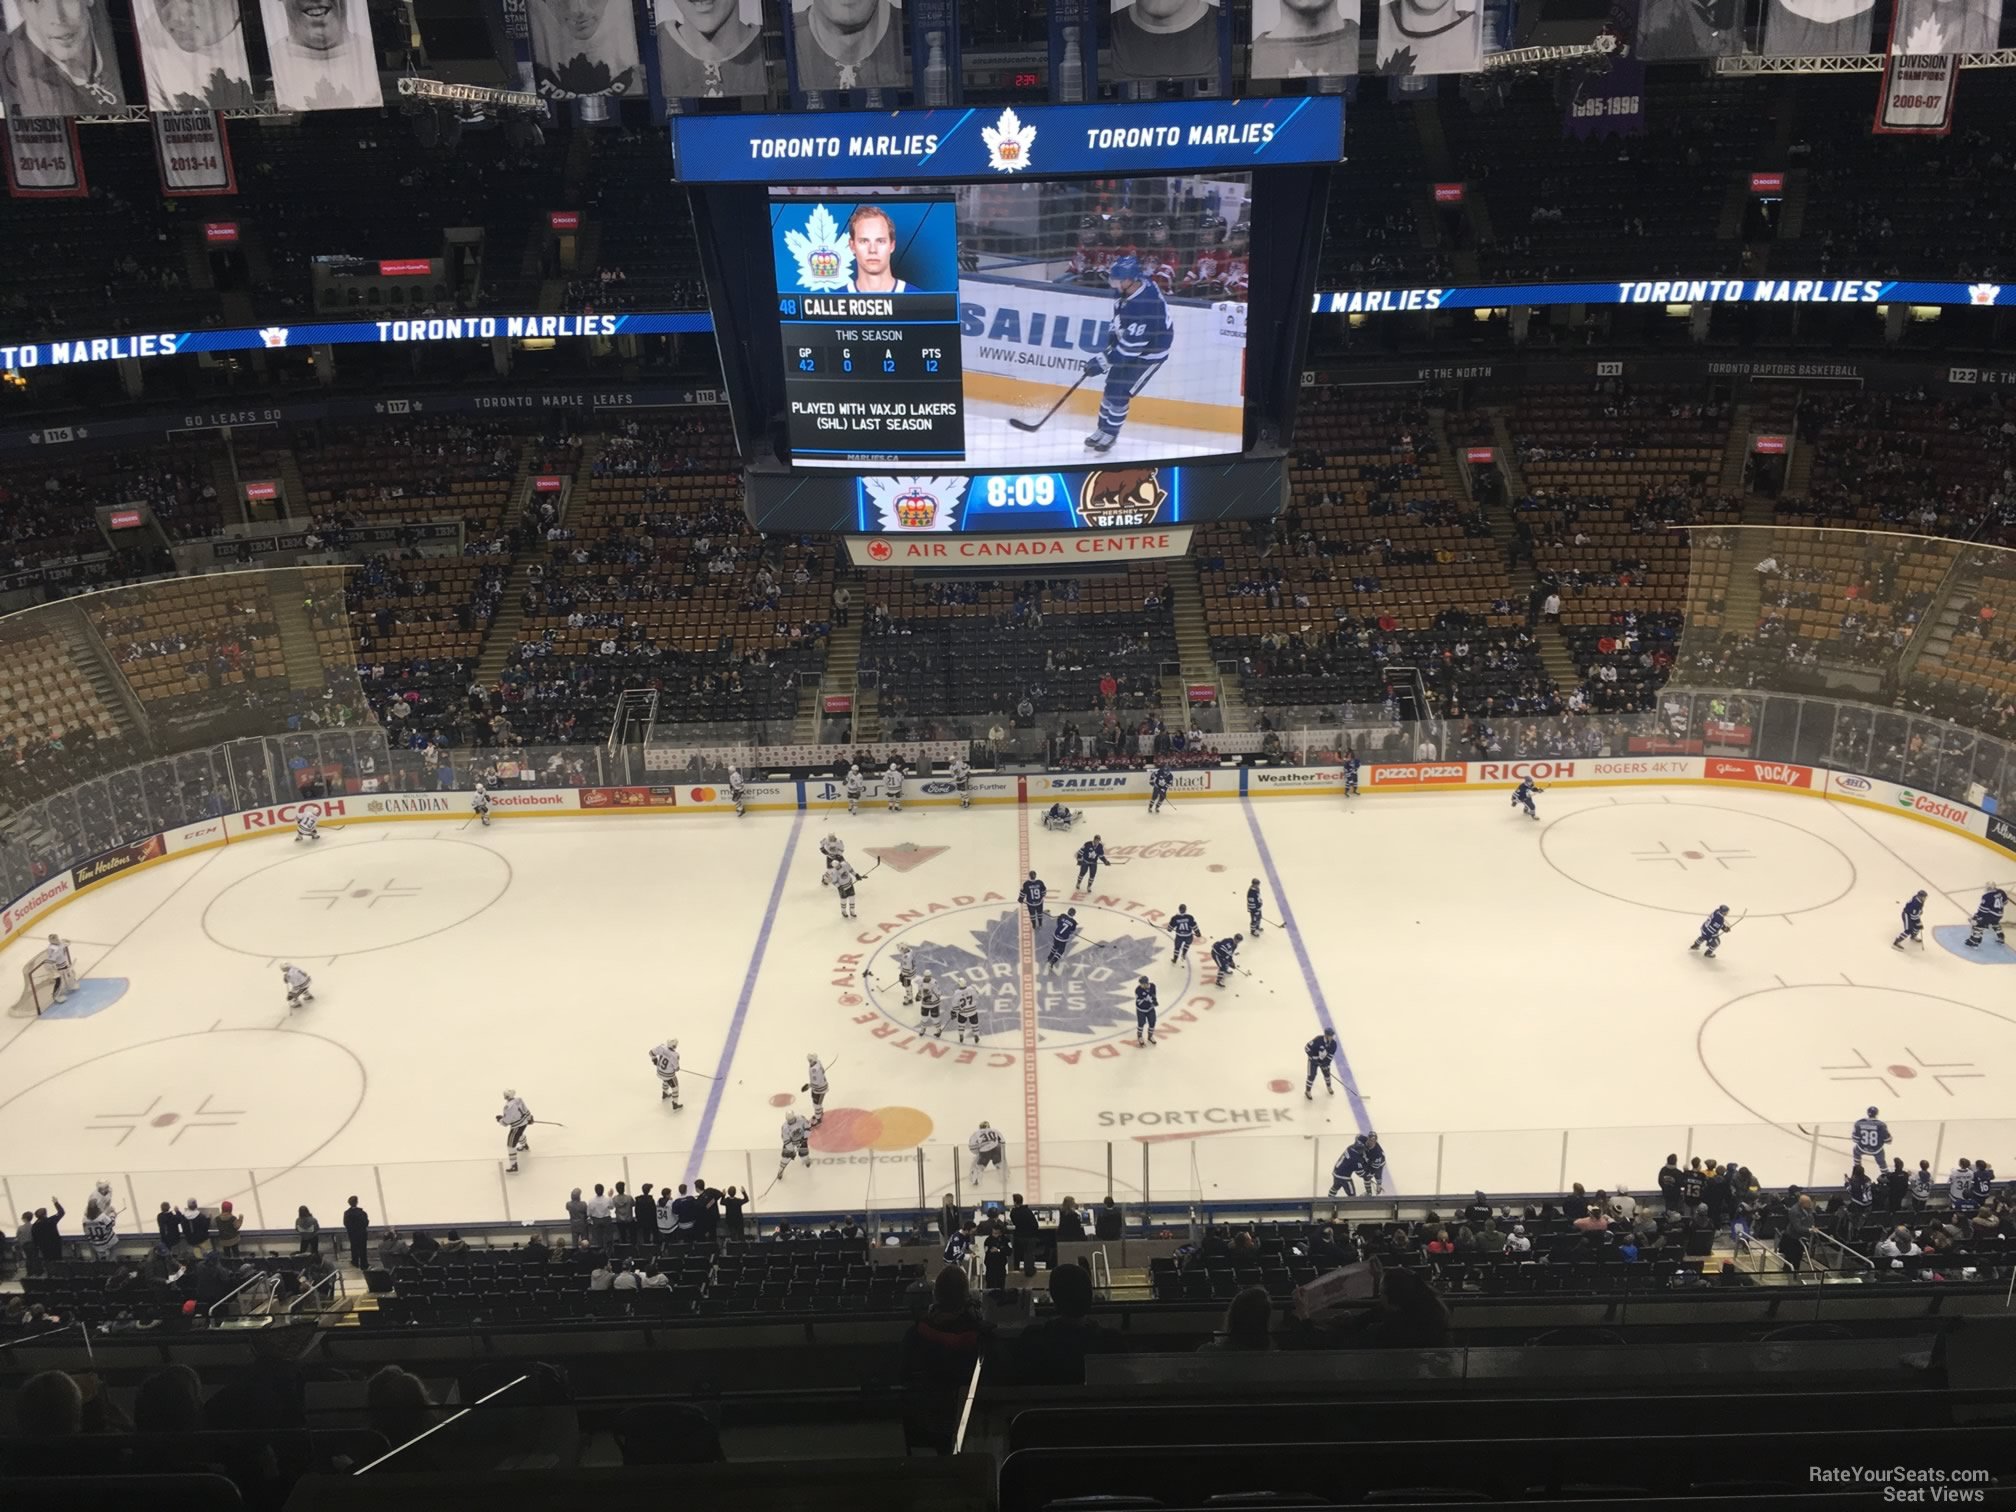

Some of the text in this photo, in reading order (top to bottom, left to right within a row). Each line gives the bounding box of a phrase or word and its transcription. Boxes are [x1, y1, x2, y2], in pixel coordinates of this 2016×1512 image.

[972, 56, 1048, 65] aircanadacentre.co
[1899, 55, 1948, 68] DIVISION
[1897, 71, 1946, 80] CHAMPIONS
[1893, 95, 1942, 108] 2006-07
[12, 118, 61, 132] DIVISION
[163, 117, 212, 131] DIVISION
[1087, 123, 1275, 149] TORONTO MARLIES
[750, 134, 938, 158] TORONTO MARLIES
[20, 157, 66, 171] 2014-15
[171, 157, 217, 171] 2013-14
[1618, 280, 1882, 303] TORONTO MARLIES
[779, 299, 893, 316] 48 CALLE ROSEN
[1330, 289, 1442, 312] MARLIES
[376, 314, 617, 342] TORONTO MARLIES
[959, 302, 1112, 354] SAILU
[1127, 322, 1147, 337] 48
[836, 330, 902, 341] THIS SEASON
[3, 333, 177, 369] TO MARLIES
[799, 348, 941, 359] GP G A PTS
[799, 360, 938, 372] 42 0 12 12
[978, 345, 1088, 373] WWW.SAILUNTIR
[1418, 367, 1492, 380] WE THE NORTH
[1600, 363, 1620, 375] 121
[1708, 362, 1858, 376] TORONTO RAPTORS BASKETBALL
[1952, 369, 2016, 384] 122 WE TH
[474, 393, 633, 408] TORONTO MAPLE LEAFS
[698, 389, 715, 402] 118
[389, 401, 408, 413] 117
[792, 402, 956, 416] PLAYED WITH VAXJO LAKERS
[185, 409, 281, 426] GO LEAFS GO
[817, 418, 932, 431] (SHL) LAST SEASON
[48, 430, 68, 442] 116
[987, 475, 1055, 507] 8:09
[1102, 508, 1139, 516] HERSHEY
[1098, 513, 1143, 527] BEARS
[375, 531, 396, 541] IBM
[435, 526, 457, 537] IBM
[249, 542, 273, 552] IBM
[907, 535, 1169, 557] AIR CANADA CENTRE
[1375, 765, 1463, 782] pizza pizza
[1480, 763, 1574, 780] RICOH
[1594, 762, 1688, 773] ROGERS 4K TV
[887, 776, 895, 786] 21
[1051, 777, 1127, 788] SAILUN
[1844, 778, 1866, 790] AHL
[720, 786, 780, 797] maerpass
[927, 784, 950, 793] Ford
[385, 798, 449, 812] CANADIAN
[492, 794, 564, 806] Scotiabank
[1915, 796, 1968, 825] Castrol
[304, 816, 315, 828] 13
[184, 826, 217, 840] CCM
[76, 855, 130, 883] Tim Hortons
[14, 880, 68, 921] Scotiabank
[1030, 889, 1041, 900] 19
[1060, 922, 1069, 934] 7
[831, 953, 863, 987] AIR
[856, 890, 1006, 945] CANADA
[852, 1011, 1016, 1068] CENTRE
[657, 1055, 669, 1070] 19
[979, 1131, 996, 1143] 30
[1860, 1130, 1879, 1147] 38
[1685, 1184, 1700, 1198] 13
[1917, 1182, 1929, 1193] 34
[1957, 1180, 1969, 1191] 34
[1979, 1181, 1989, 1192] 16
[657, 1208, 668, 1220] 34
